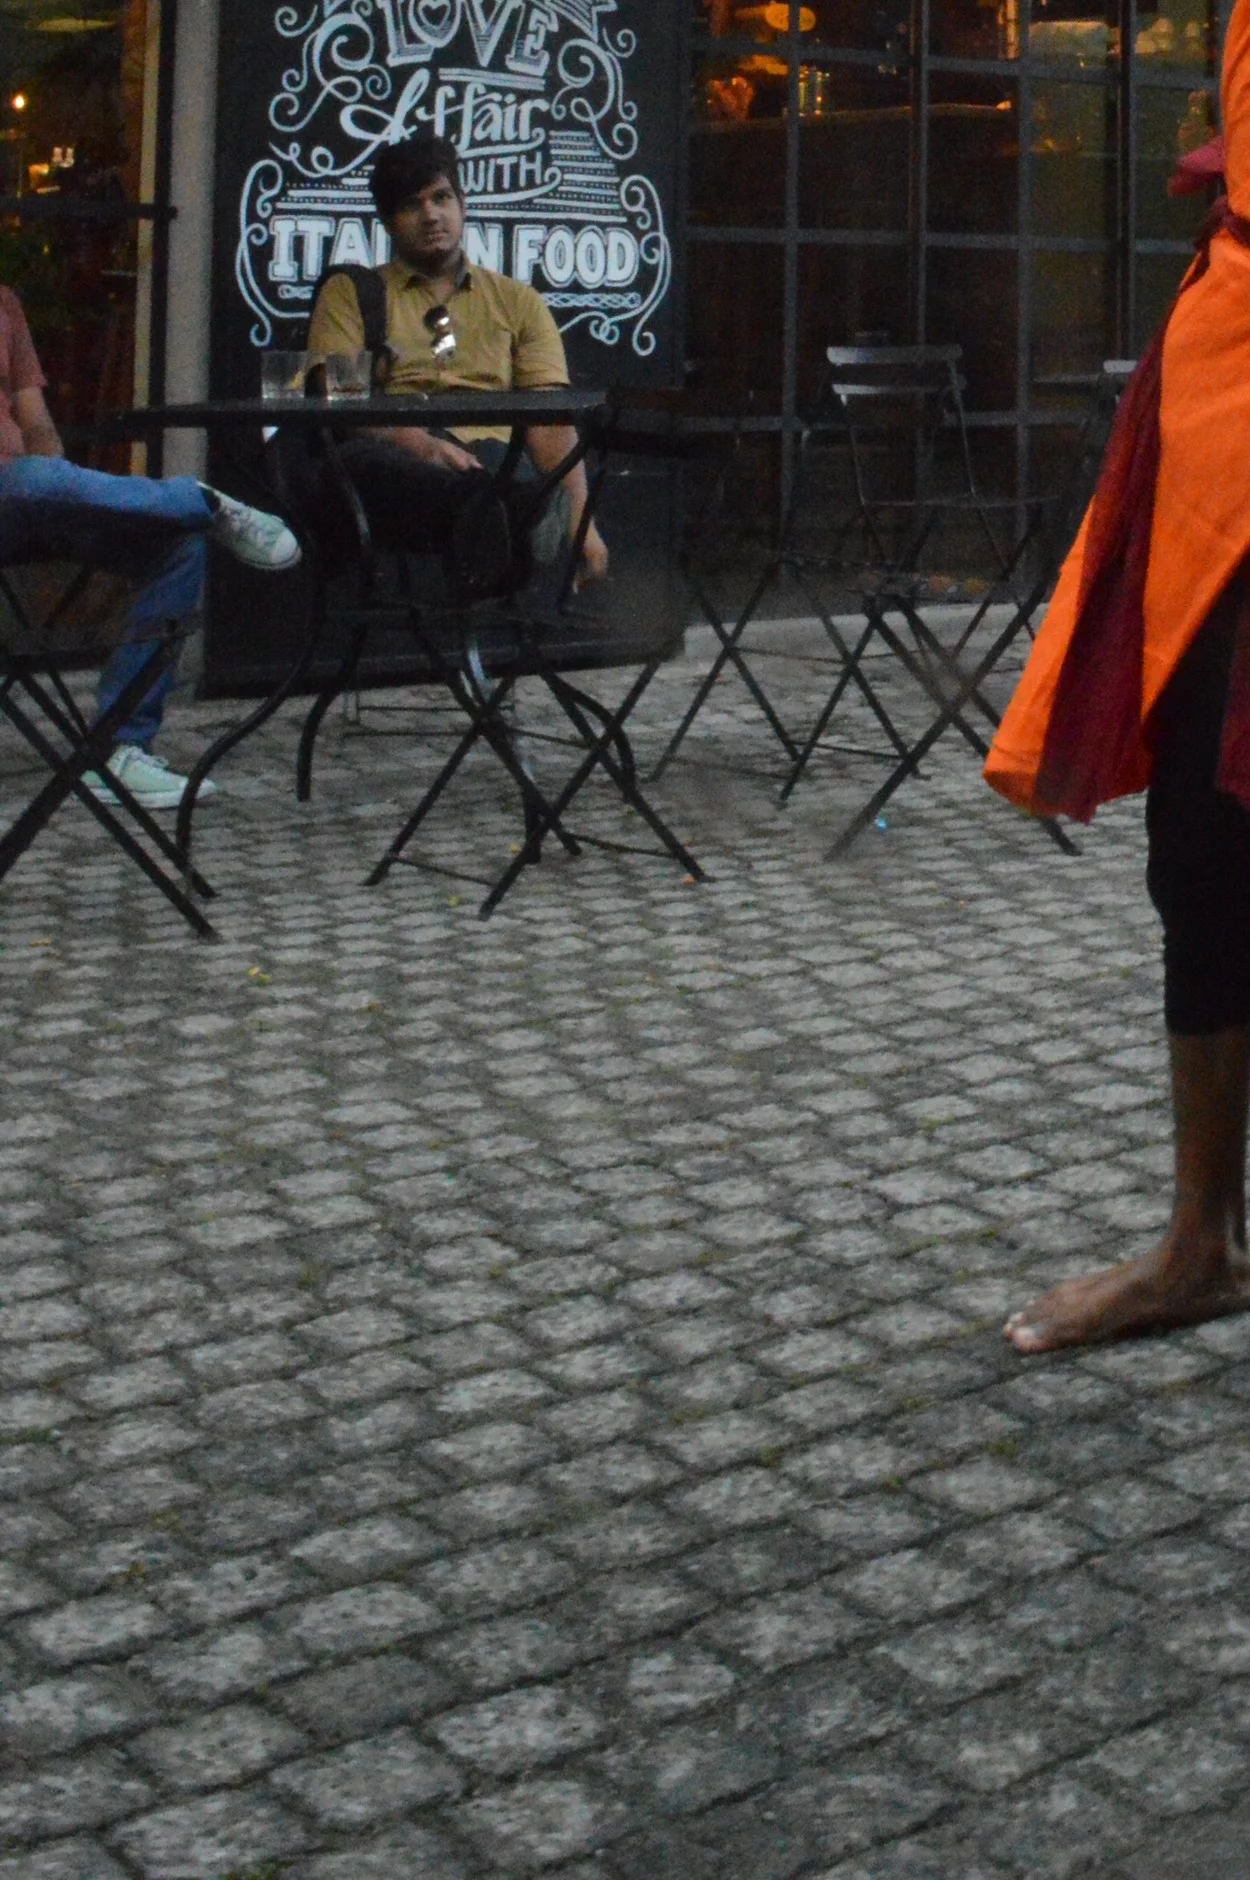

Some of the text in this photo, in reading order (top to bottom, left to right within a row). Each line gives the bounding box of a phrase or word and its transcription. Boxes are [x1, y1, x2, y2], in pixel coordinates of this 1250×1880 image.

[457, 151, 543, 194] WITH
[267, 215, 640, 289] ITAN FOOD
